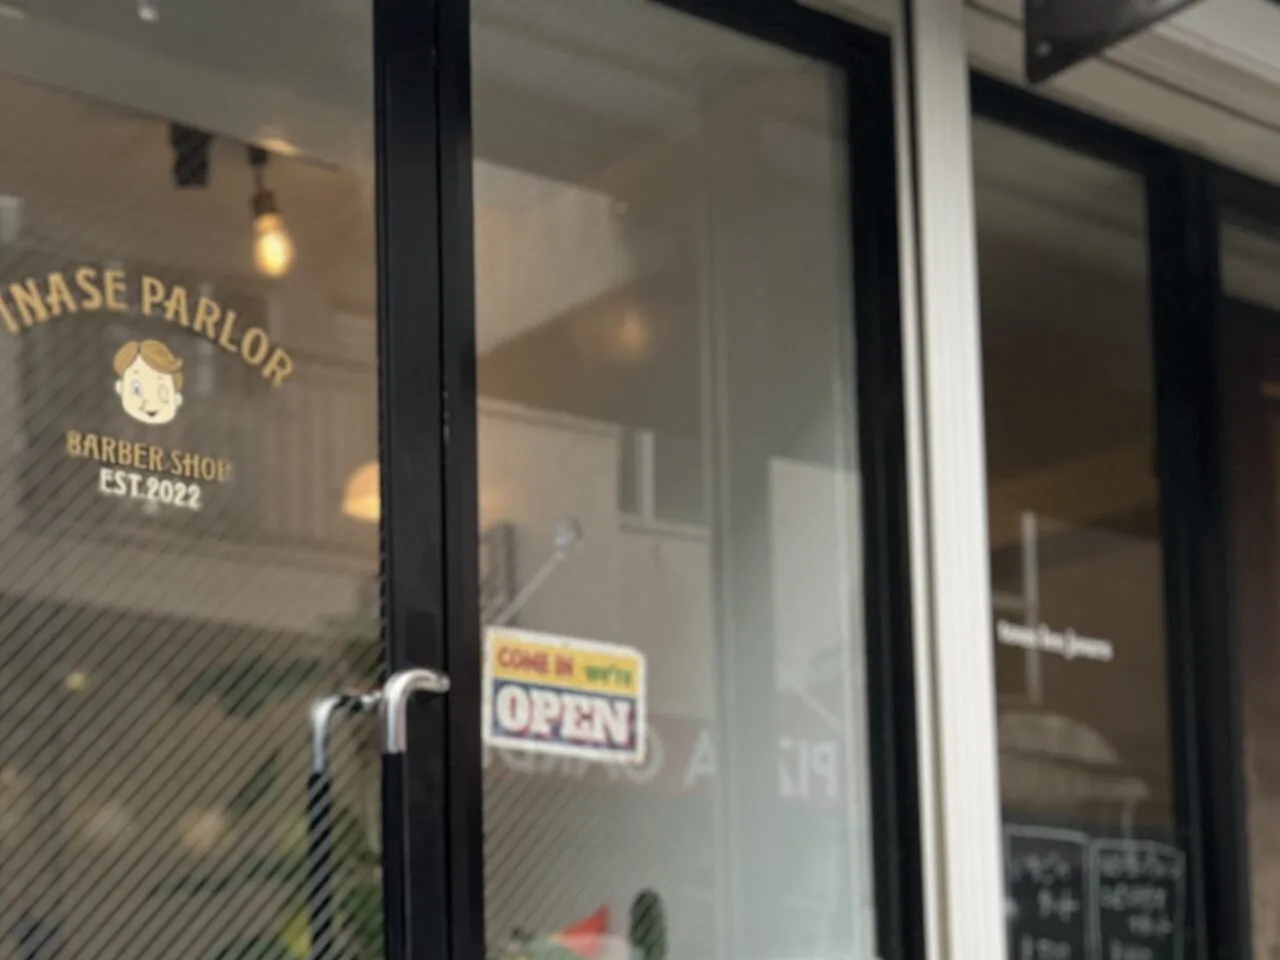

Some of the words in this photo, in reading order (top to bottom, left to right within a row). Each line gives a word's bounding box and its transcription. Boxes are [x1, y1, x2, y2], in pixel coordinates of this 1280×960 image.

[141, 275, 295, 388] PARLOR
[66, 430, 163, 473] BARBER
[169, 450, 231, 482] SHOP
[496, 645, 549, 676] COME
[555, 654, 574, 679] IN
[496, 684, 632, 747] OPEN
